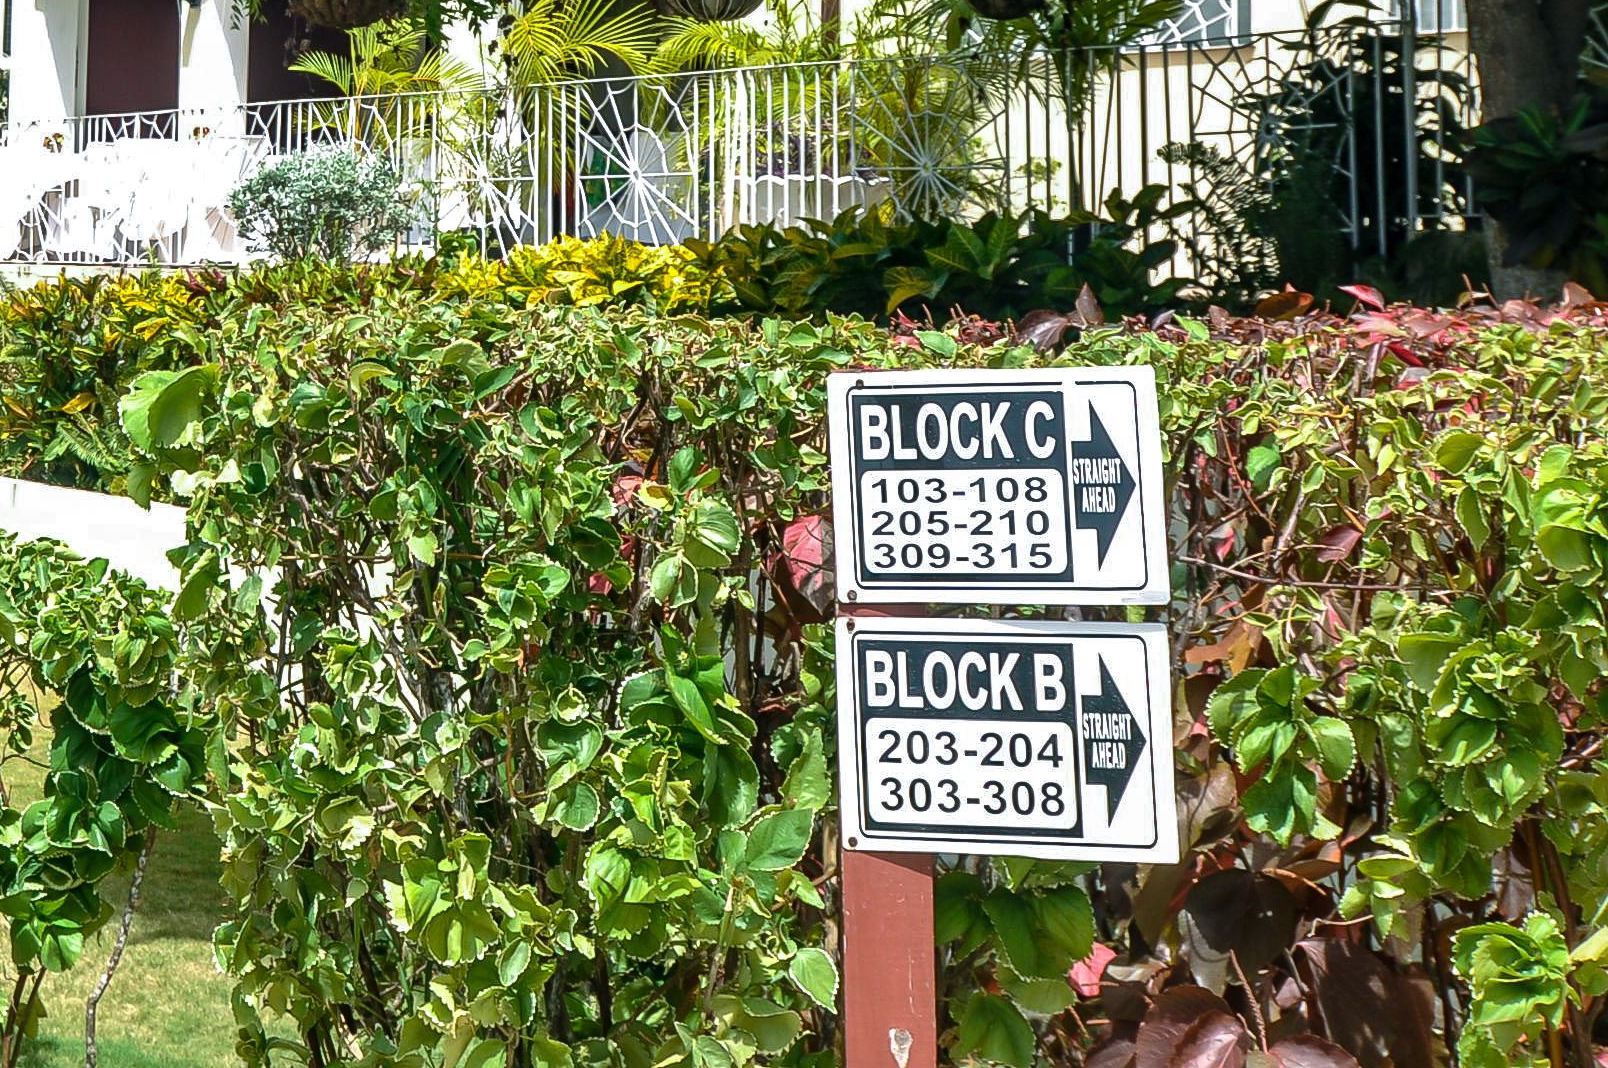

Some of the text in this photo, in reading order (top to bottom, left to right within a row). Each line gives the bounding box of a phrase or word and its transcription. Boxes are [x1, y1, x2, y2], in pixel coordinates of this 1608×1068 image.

[861, 401, 1057, 461] BLOCK C
[1073, 457, 1121, 485] STRAIGHT
[871, 477, 1048, 504] 103-108
[1082, 486, 1116, 513] AHEAD
[871, 509, 1050, 536] 205-210
[873, 542, 1053, 569] 309-315
[865, 649, 1067, 712] BLOCK B
[1082, 712, 1132, 740] STRAIGHT
[878, 729, 1064, 768] 203-204
[1091, 741, 1126, 770] AHEAD
[880, 776, 1066, 817] 303-308
